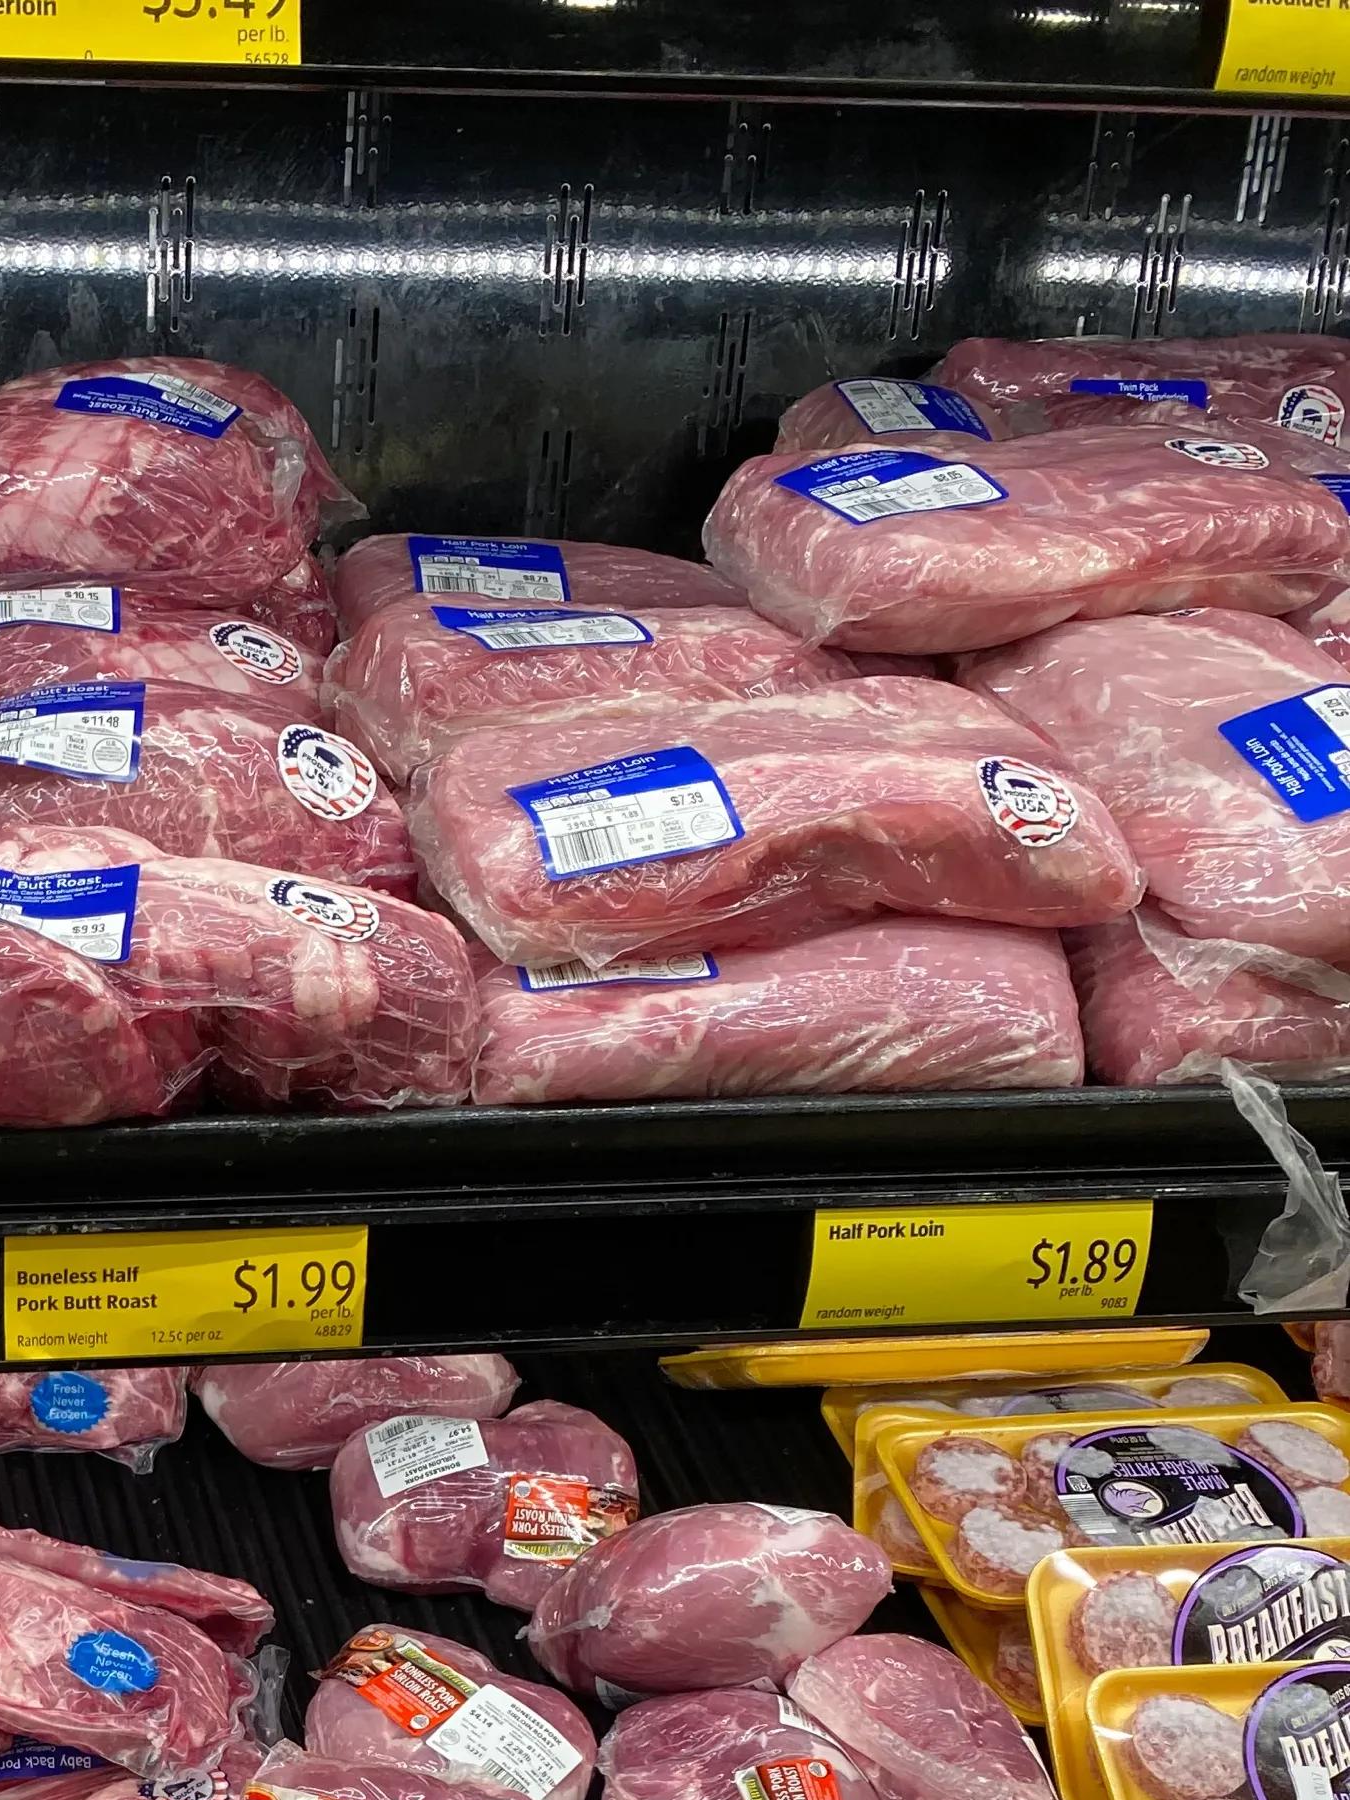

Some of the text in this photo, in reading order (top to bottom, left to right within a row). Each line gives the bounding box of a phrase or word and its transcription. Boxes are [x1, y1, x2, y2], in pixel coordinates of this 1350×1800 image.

[1235, 65, 1336, 90] random weight
[240, 649, 272, 667] USA
[548, 773, 579, 786] Half
[583, 764, 620, 779] Pork
[622, 755, 656, 769] Loin
[1015, 799, 1048, 815] USA
[17, 879, 51, 890] Butt
[57, 875, 102, 888] Roast
[829, 1220, 945, 1240] Half Pork Loin
[1026, 1238, 1137, 1289] $1.89
[17, 1266, 139, 1286] Boneless Half
[233, 1259, 356, 1314] $1.99
[16, 1293, 158, 1312] Pork Butt Roast
[1101, 1297, 1128, 1309] 9083
[816, 1304, 905, 1320] random weight
[314, 1324, 353, 1337] 48829
[52, 1384, 85, 1395] Fresh
[52, 1396, 86, 1408] Never
[49, 1408, 88, 1421] Frozen
[1184, 1474, 1230, 1491] MAPLE
[514, 1508, 546, 1523] ROAST
[512, 1521, 539, 1536] PORK
[97, 1643, 135, 1662] Fresh
[390, 1670, 422, 1698] SIRLOIN
[417, 1692, 449, 1714] ROAST
[401, 1662, 437, 1693] BONELESS
[434, 1687, 460, 1708] PORK
[767, 1766, 784, 1791] PORK
[783, 1766, 803, 1793] ROAST
